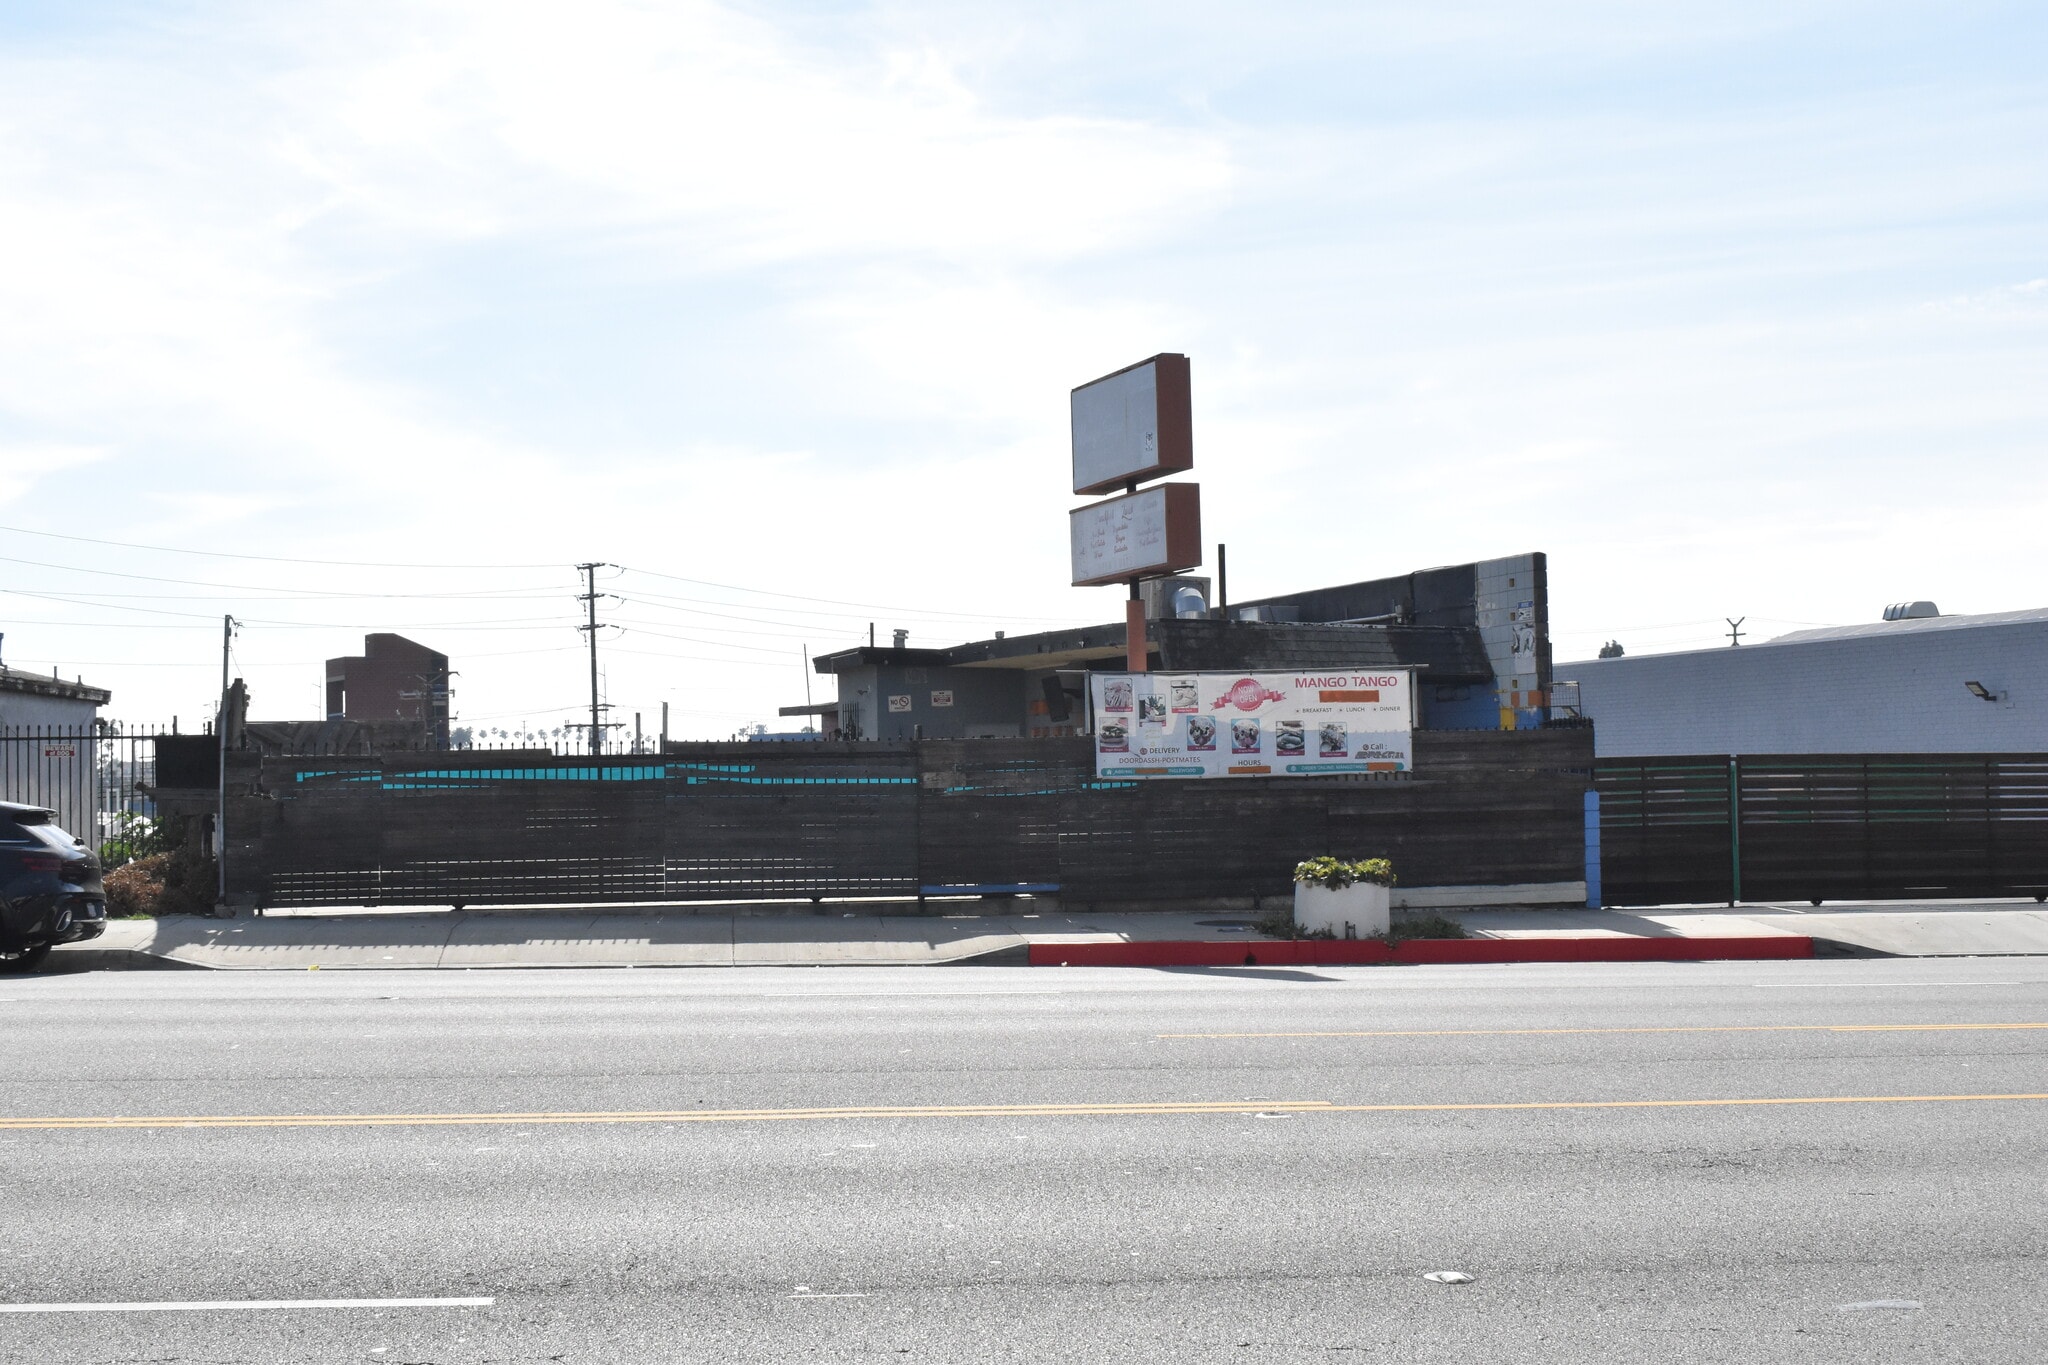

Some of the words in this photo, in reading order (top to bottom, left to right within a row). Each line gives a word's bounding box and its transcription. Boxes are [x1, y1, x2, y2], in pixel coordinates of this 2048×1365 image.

[1295, 677, 1347, 688] MANGO
[1351, 676, 1398, 687] TANGO
[1237, 685, 1254, 695] NOW
[1239, 694, 1258, 704] OPEN
